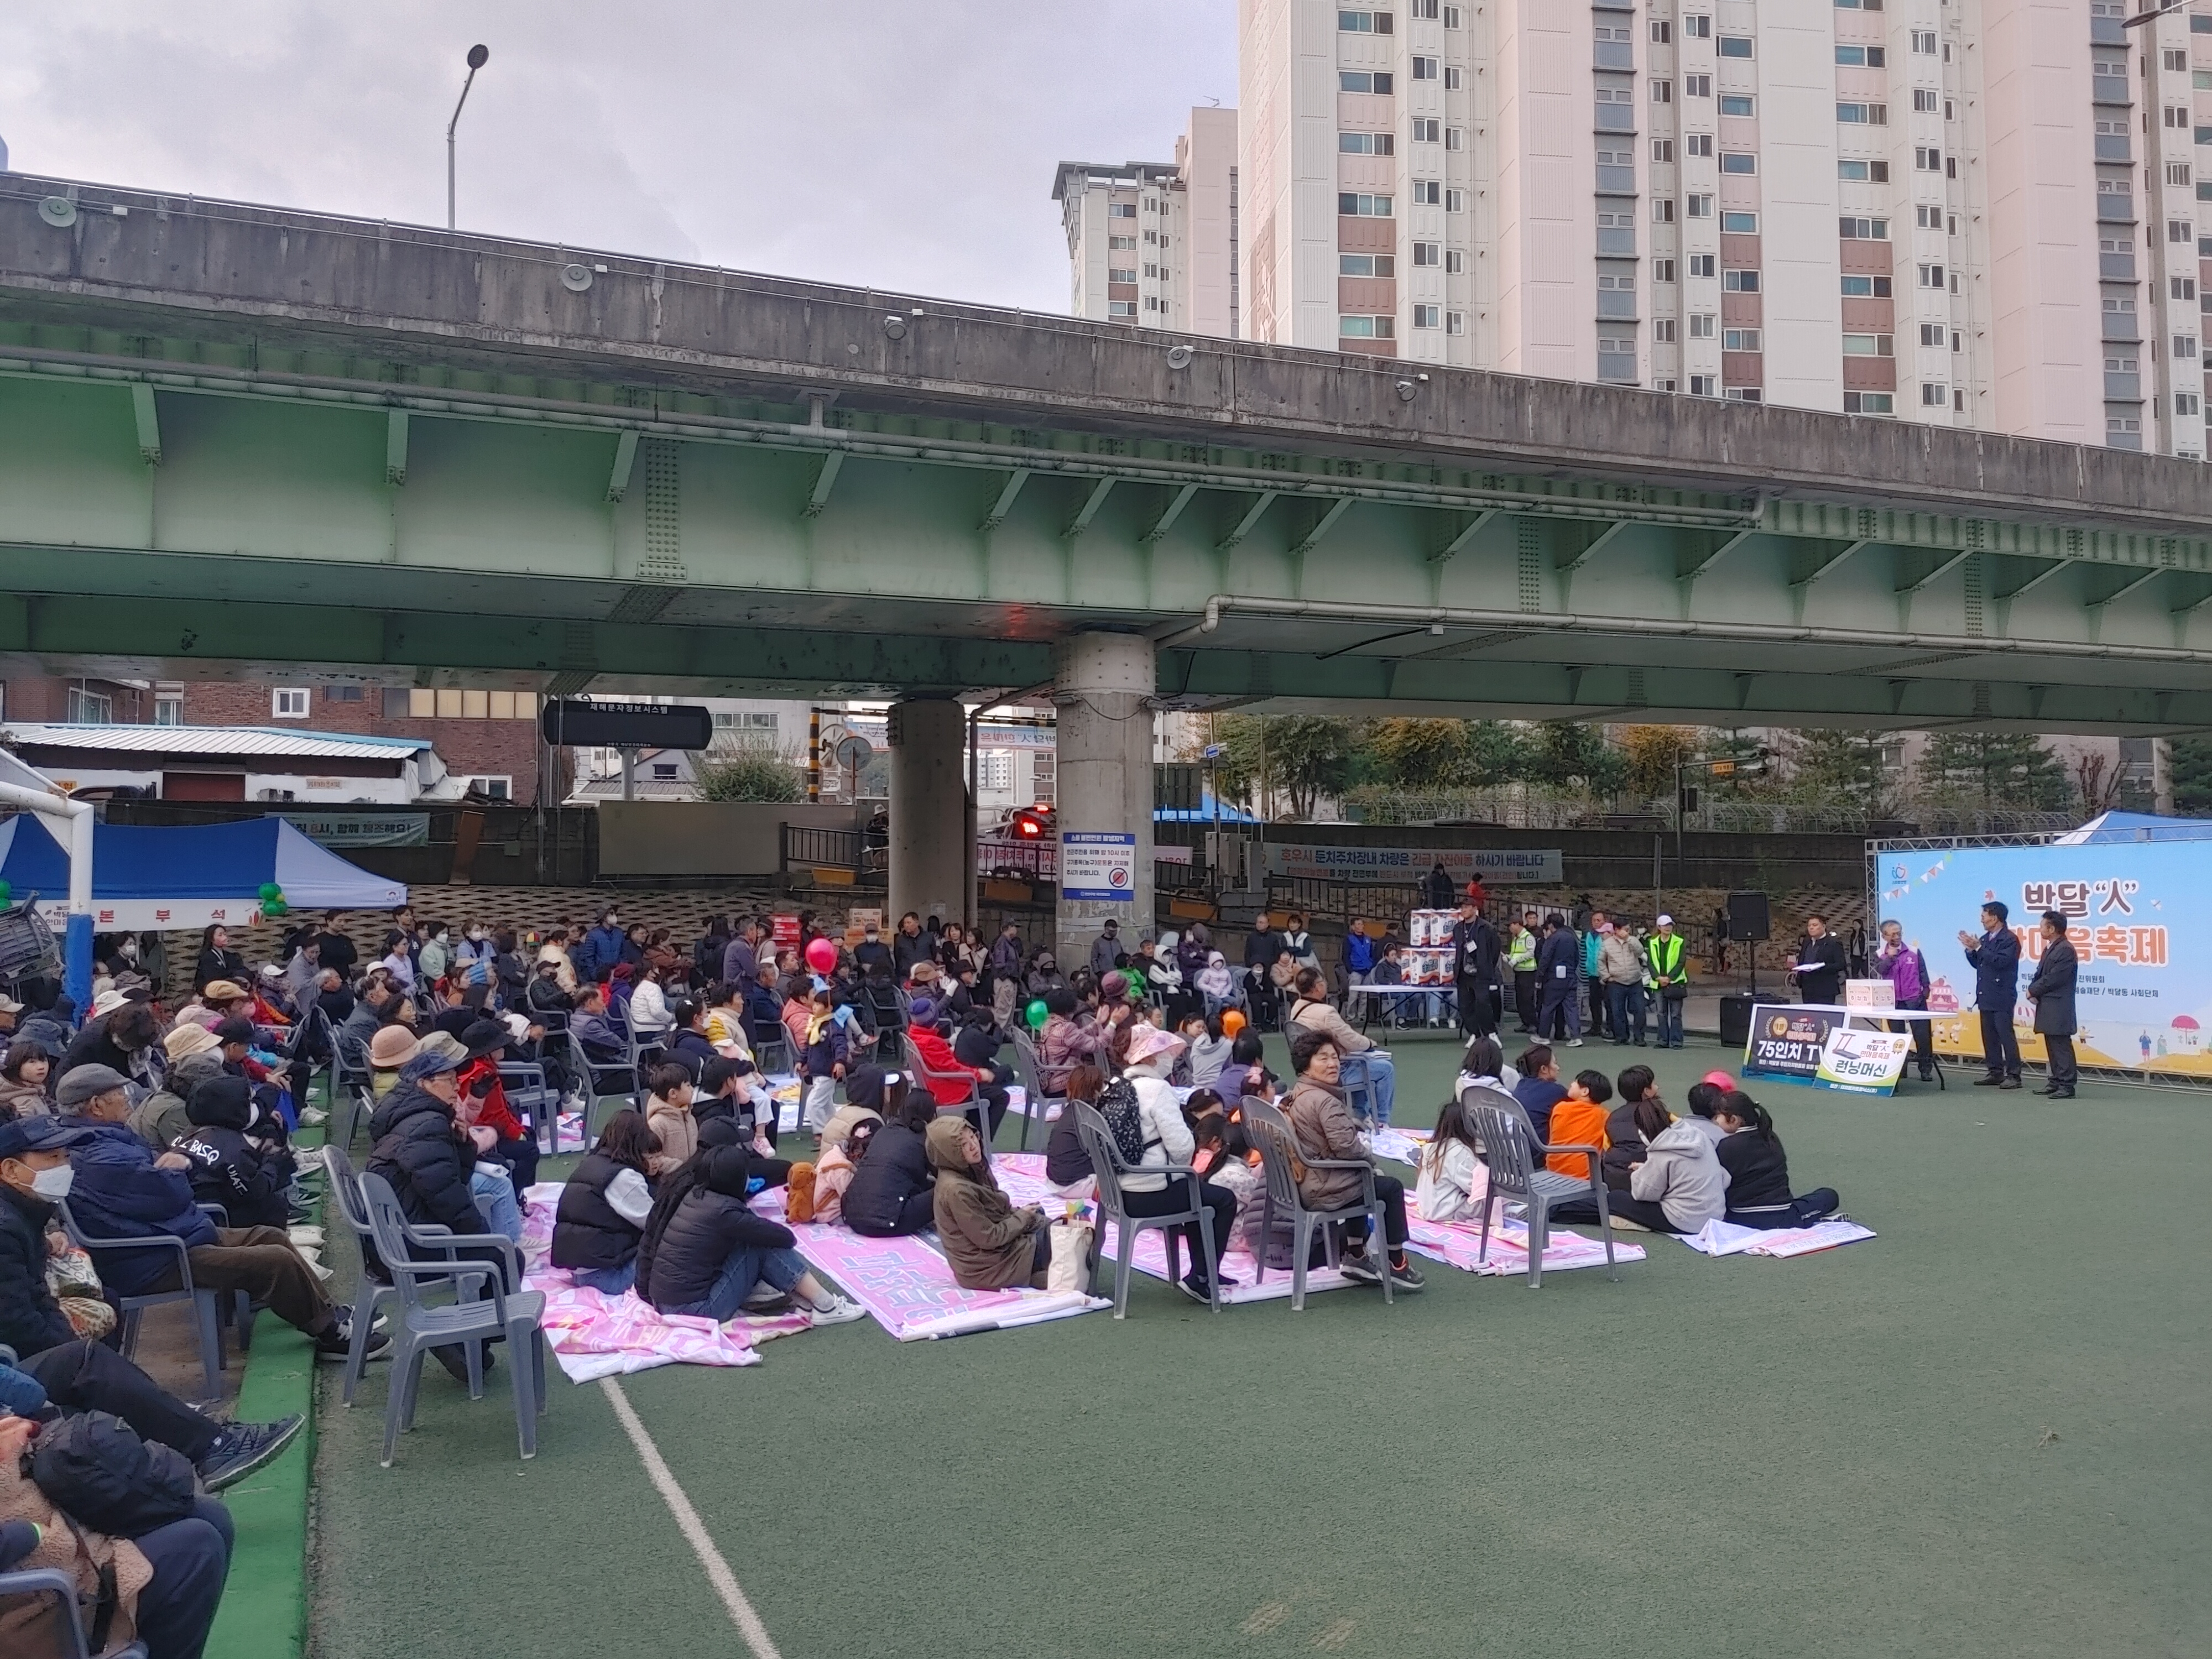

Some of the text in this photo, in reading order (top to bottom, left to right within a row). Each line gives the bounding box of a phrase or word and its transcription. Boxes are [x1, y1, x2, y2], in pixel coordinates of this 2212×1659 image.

[590, 703, 667, 714] 재해문자정보시스템
[1282, 848, 1312, 863] 호우시
[1316, 849, 1376, 865] 둔치주차장내
[1379, 852, 1410, 866] 차량은
[1476, 854, 1504, 867] 하시기
[1506, 854, 1545, 867] 바랍니다
[1757, 1040, 1803, 1061] 75인치
[1835, 1059, 1888, 1077] 런닝머신
